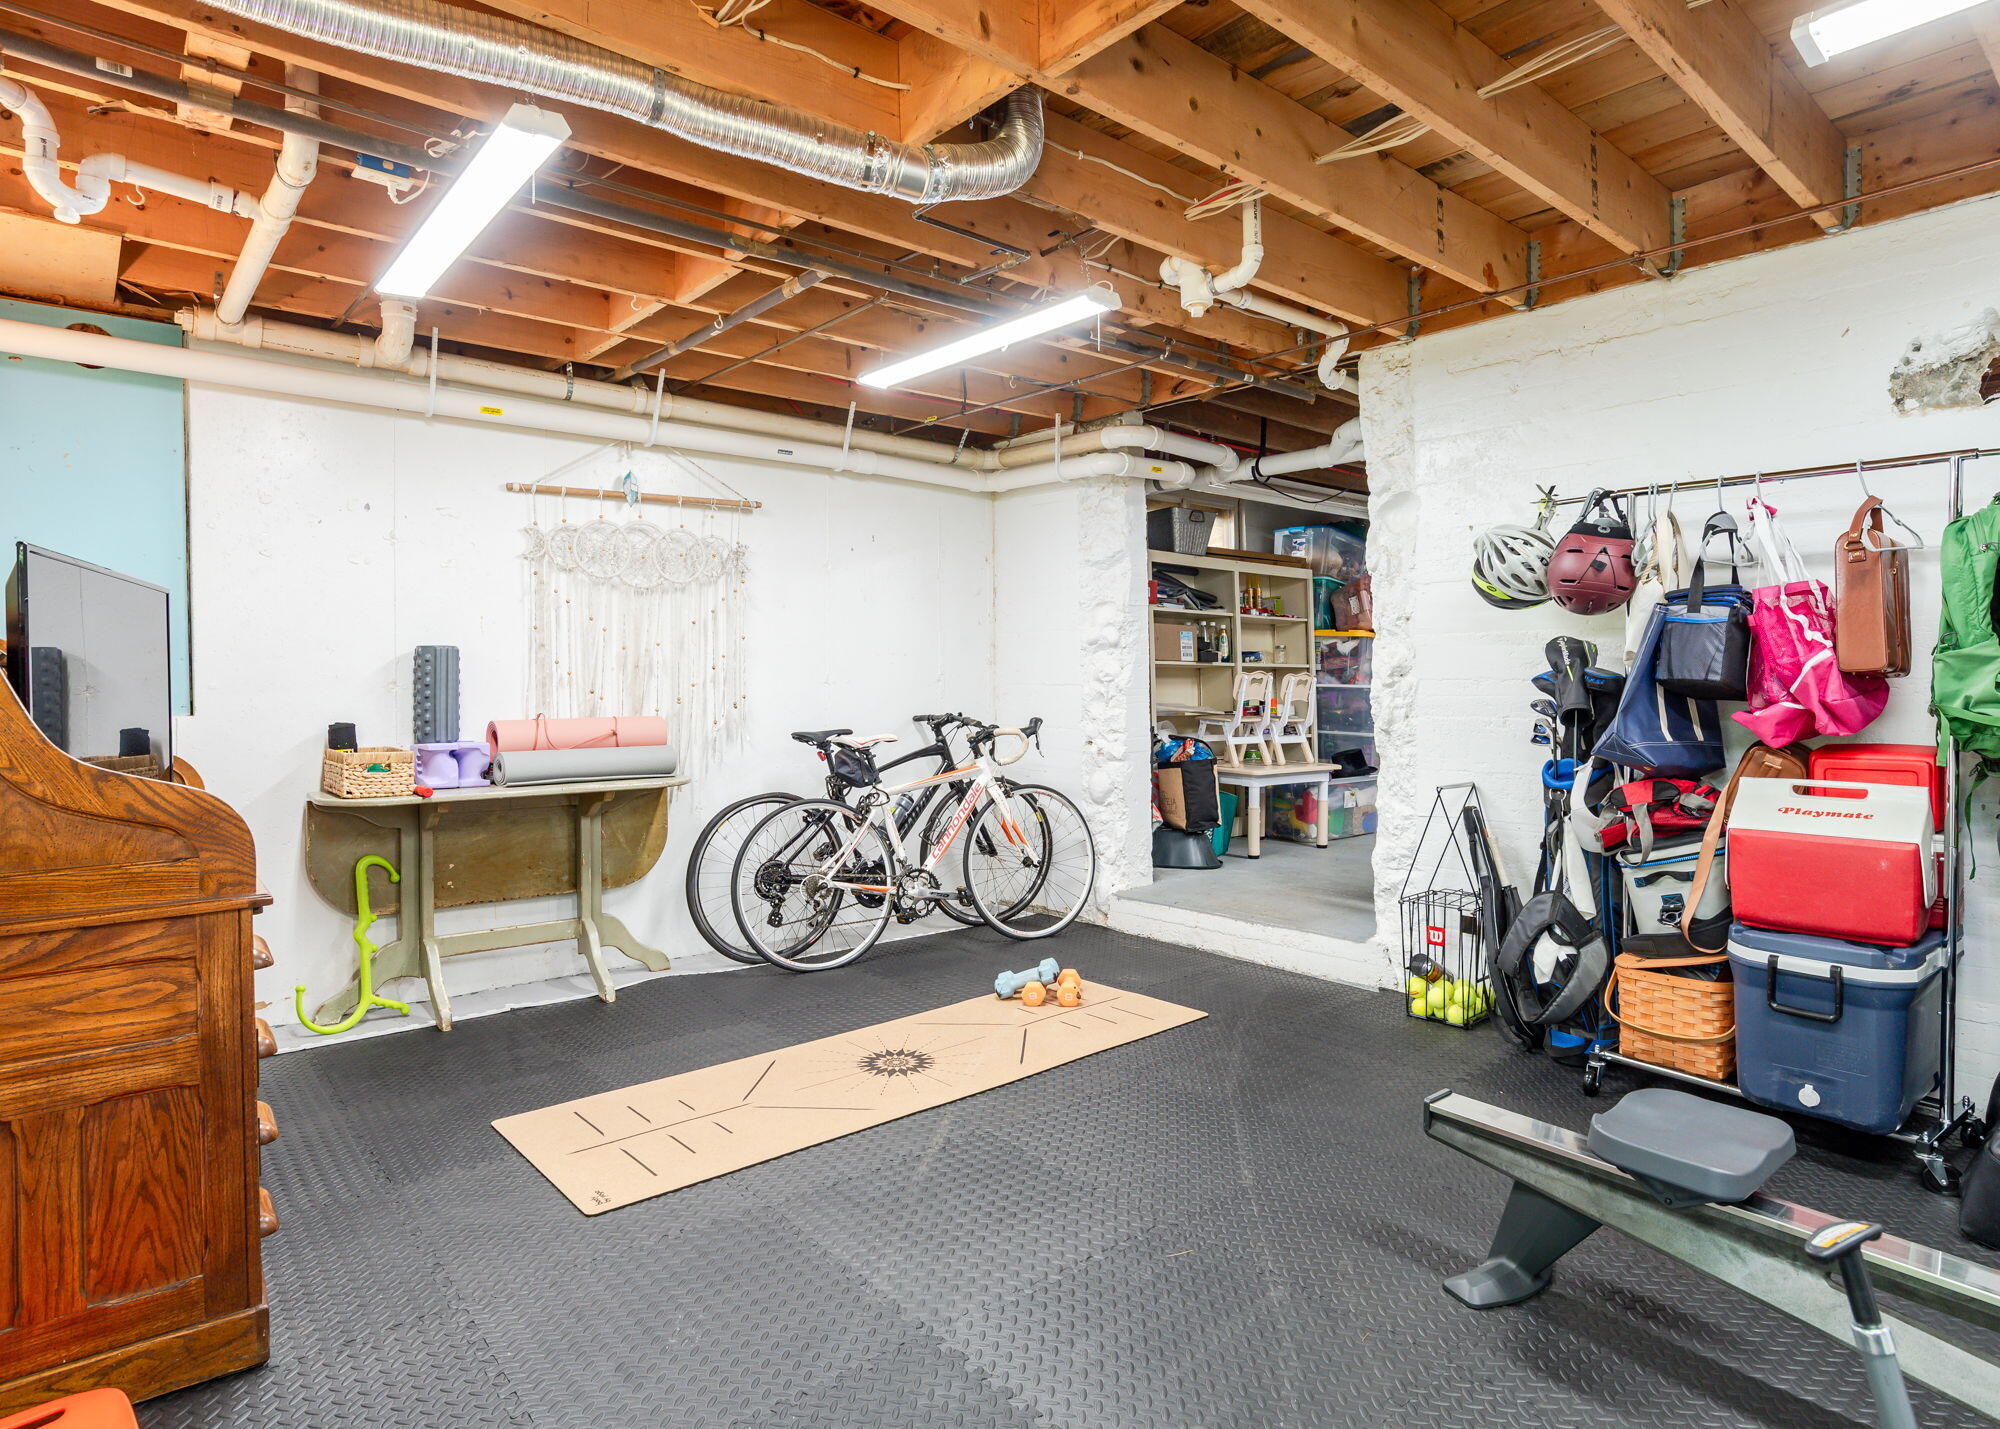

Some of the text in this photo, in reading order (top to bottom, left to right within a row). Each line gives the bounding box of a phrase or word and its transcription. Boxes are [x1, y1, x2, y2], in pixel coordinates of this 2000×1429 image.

[931, 781, 982, 859] cannondale
[1777, 806, 1875, 820] Playmate
[1429, 929, 1443, 942] W
